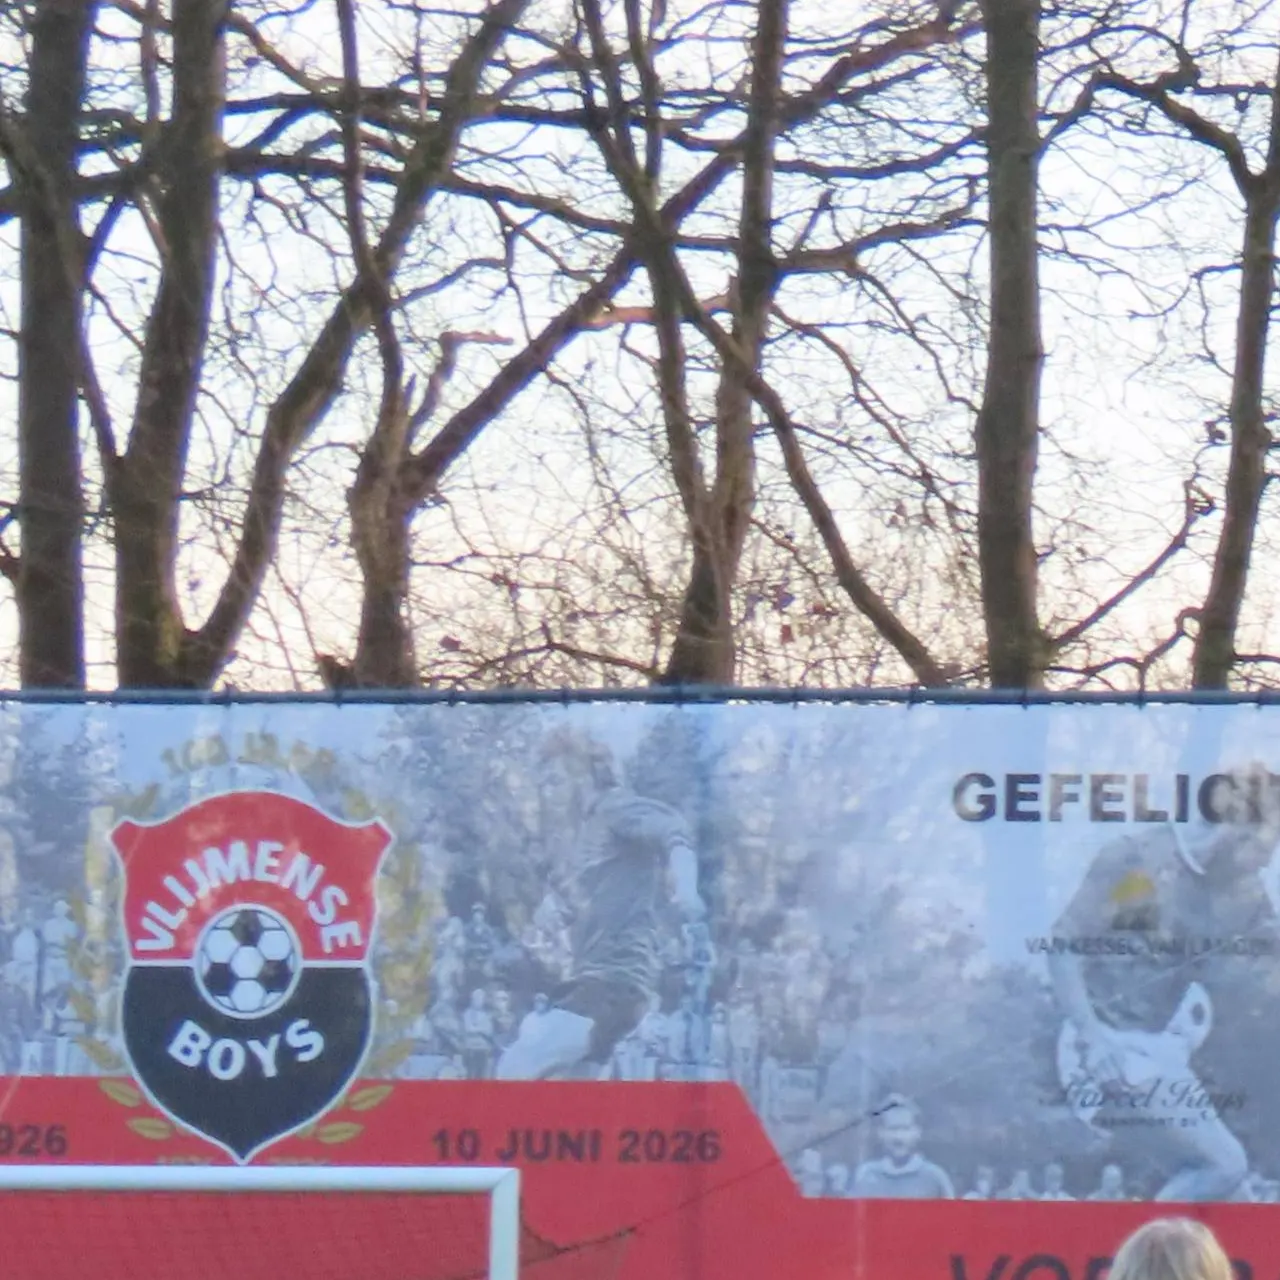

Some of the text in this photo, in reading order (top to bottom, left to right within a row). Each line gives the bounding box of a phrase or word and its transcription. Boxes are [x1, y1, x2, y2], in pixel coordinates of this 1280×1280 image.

[135, 840, 363, 953] VLIJMENSE
[168, 1018, 325, 1081] BOYS
[433, 1127, 722, 1164] 10 JUNI 2026
